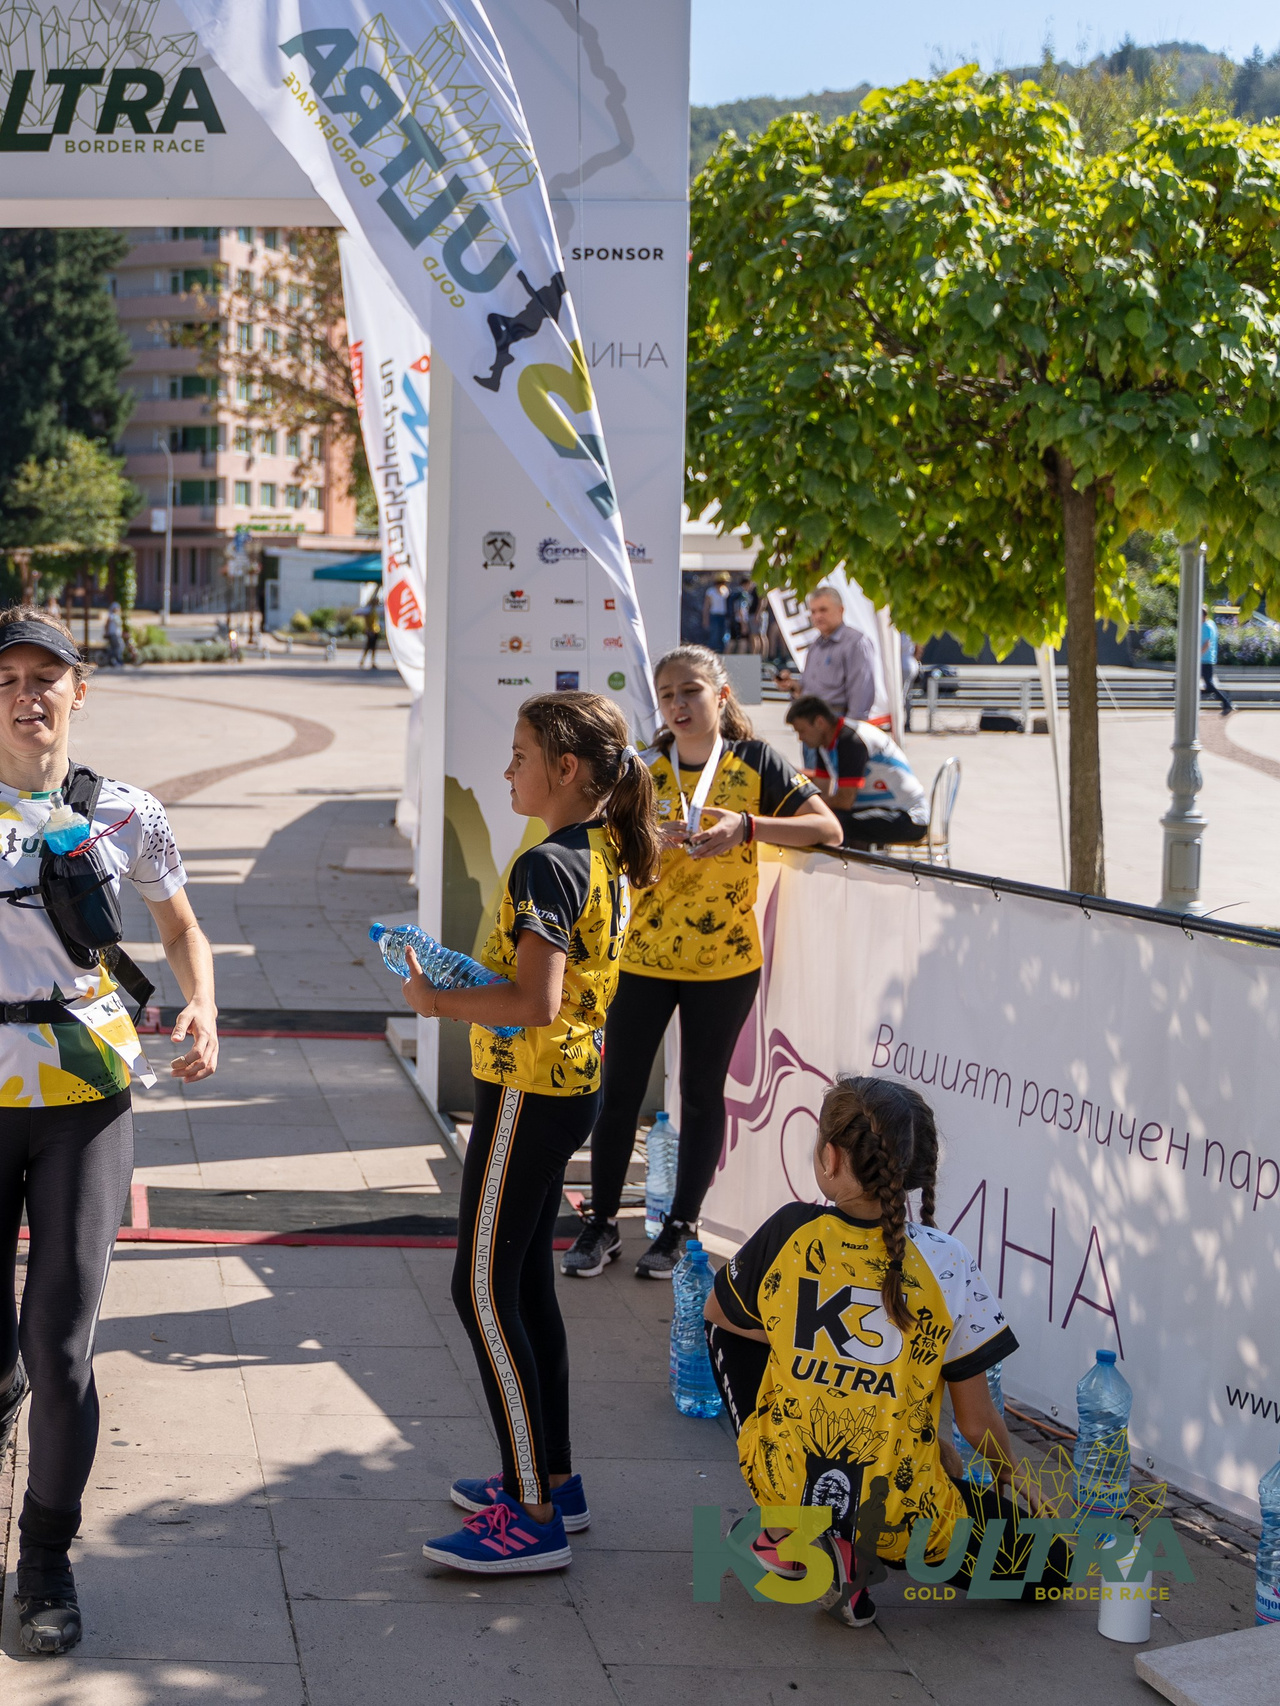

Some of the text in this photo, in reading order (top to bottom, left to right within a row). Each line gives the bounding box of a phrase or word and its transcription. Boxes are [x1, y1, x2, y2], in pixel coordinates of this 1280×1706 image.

[65, 139, 147, 154] BORDER
[153, 138, 205, 153] RACE
[572, 247, 664, 260] SPONSOR
[583, 341, 669, 369] ИНА
[502, 1087, 519, 1121] OKYO
[872, 1023, 1011, 1108] Вашият
[1018, 1079, 1190, 1170] различен
[492, 1126, 510, 1169] SEOUL
[480, 1177, 500, 1237] LONDON
[476, 1244, 490, 1275] NEW
[841, 1241, 869, 1250] Maze
[476, 1278, 491, 1313] YORK
[793, 1276, 908, 1367] K3
[915, 1305, 952, 1345] Run
[484, 1320, 507, 1365] TOKYO
[907, 1333, 939, 1366] fun
[501, 1370, 520, 1411] SEOUL
[791, 1355, 897, 1399] ULTRA
[513, 1418, 532, 1472] LONDON
